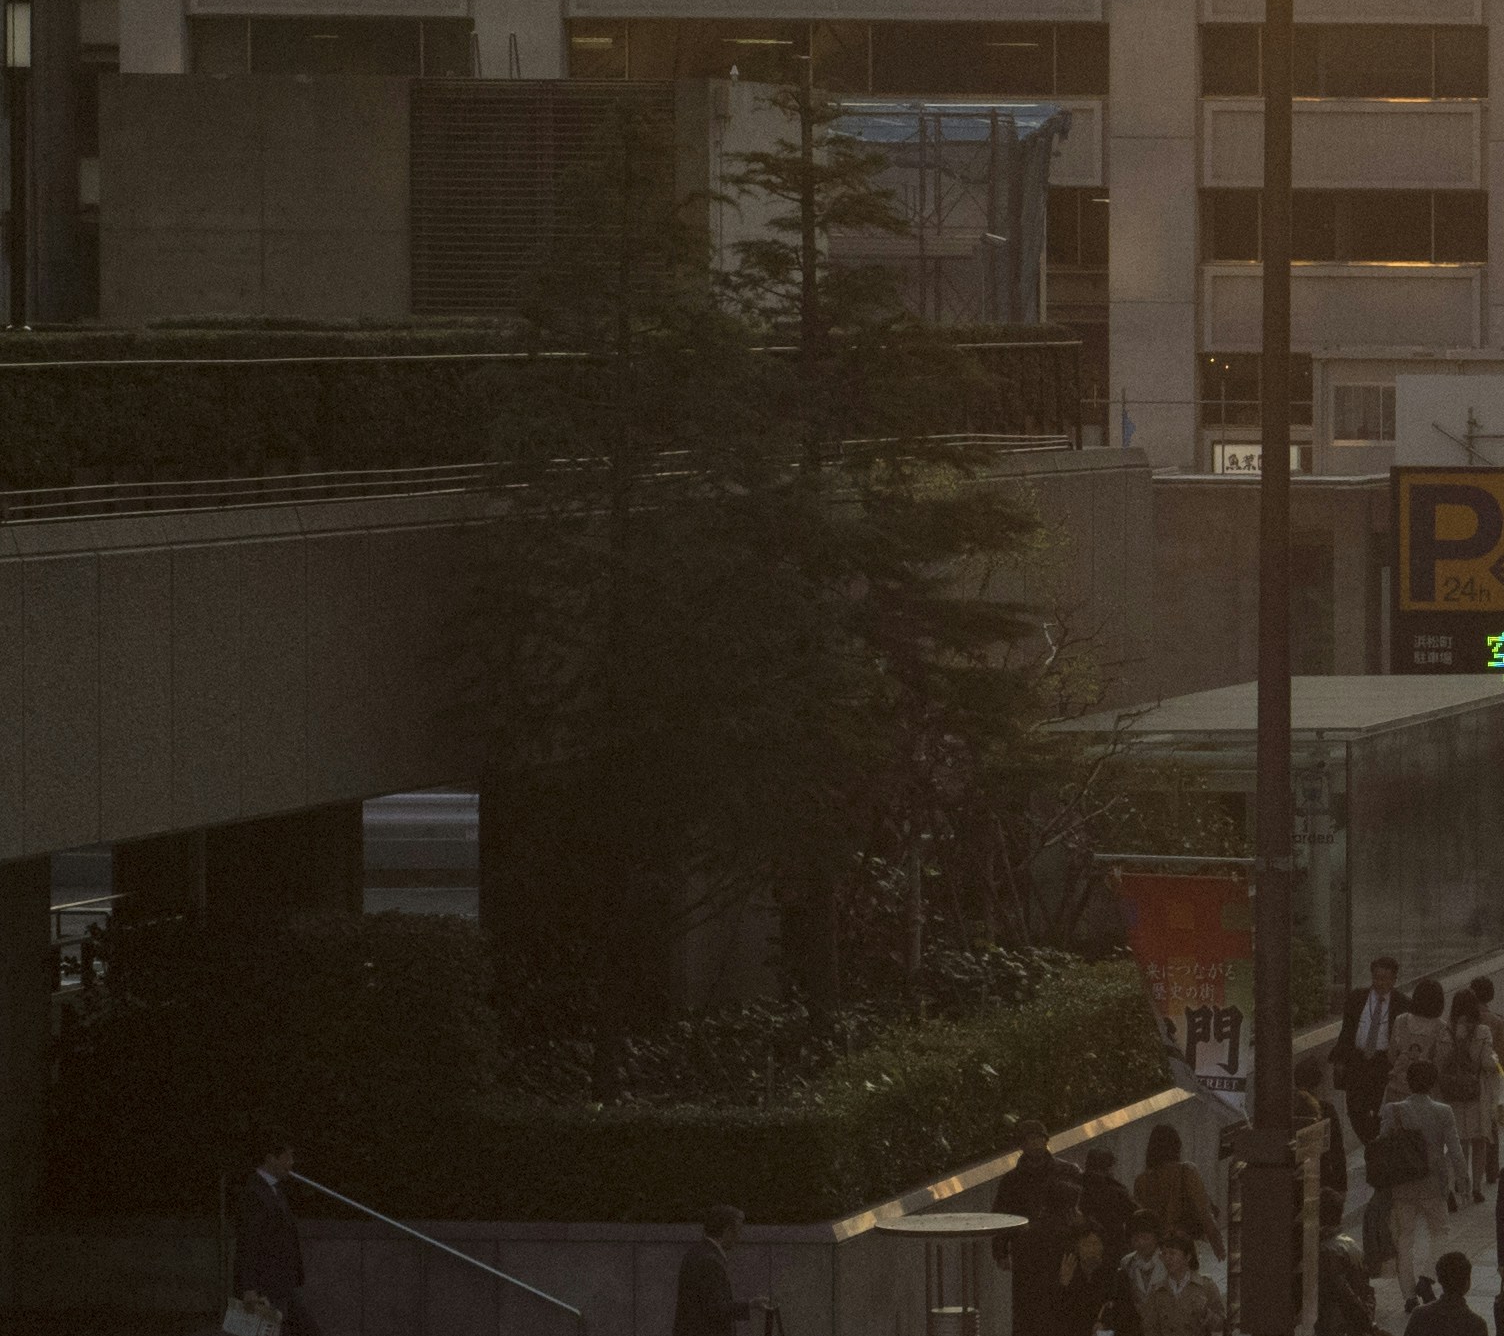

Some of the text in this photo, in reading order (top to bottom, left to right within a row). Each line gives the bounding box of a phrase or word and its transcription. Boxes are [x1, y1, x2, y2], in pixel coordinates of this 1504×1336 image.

[1409, 483, 1504, 602] P
[1443, 574, 1490, 602] 24h
[1413, 634, 1453, 649] 浜松町
